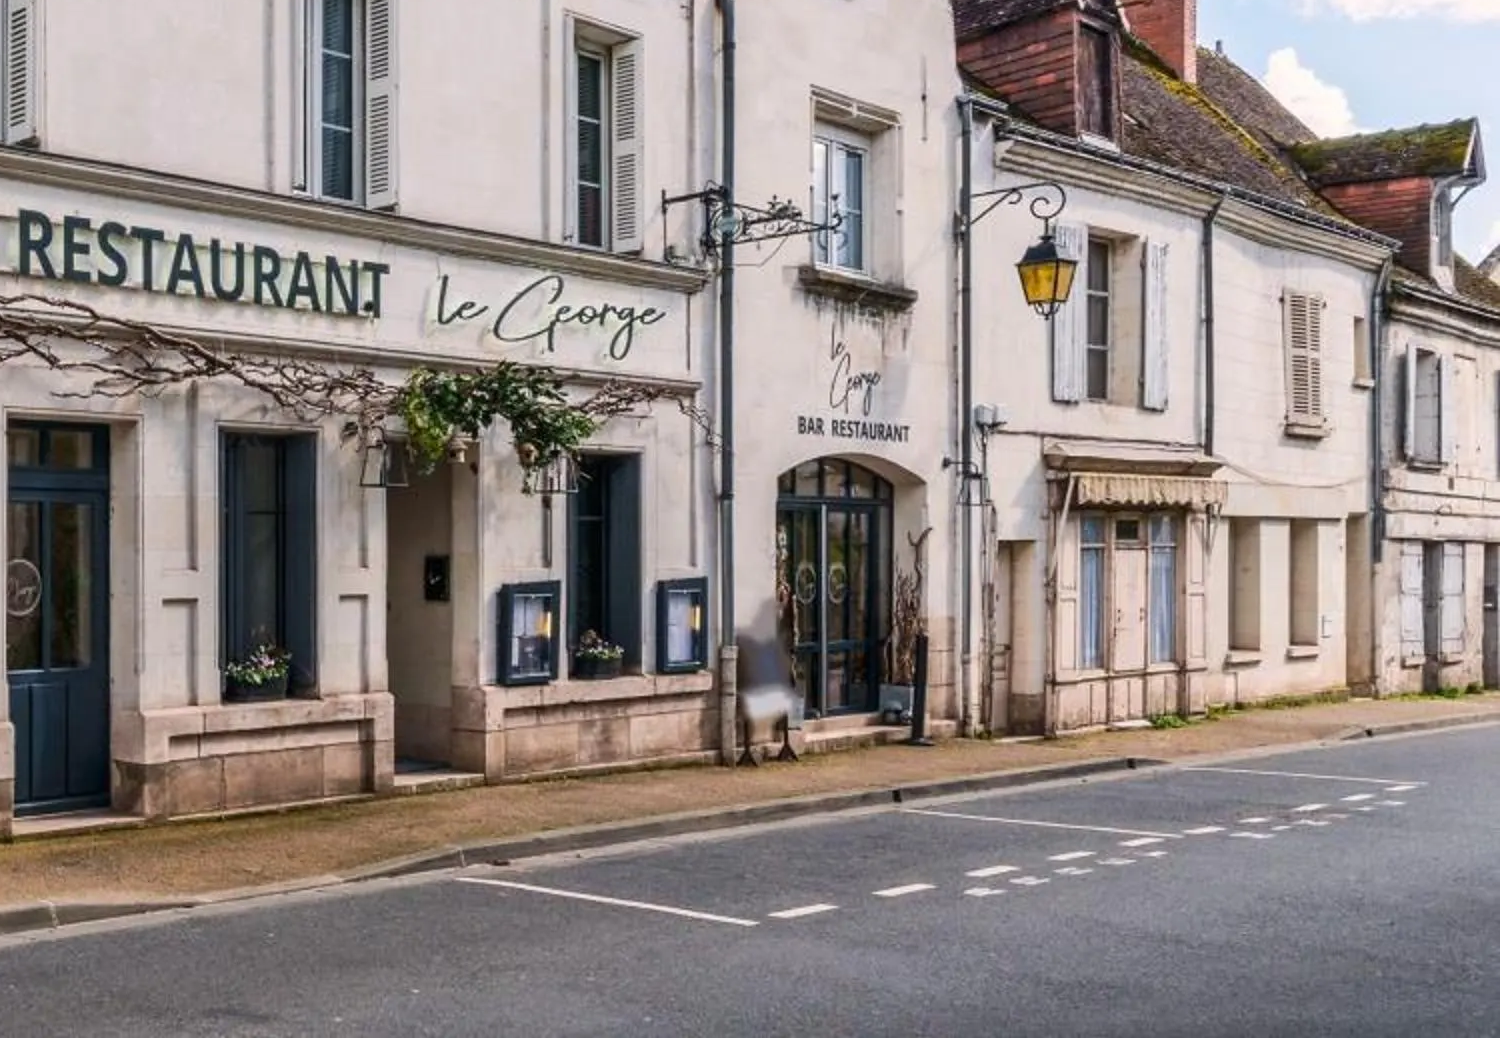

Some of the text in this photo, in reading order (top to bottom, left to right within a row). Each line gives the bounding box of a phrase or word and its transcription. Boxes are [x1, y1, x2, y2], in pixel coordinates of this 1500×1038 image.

[17, 208, 391, 319] RESTAURANT
[493, 275, 667, 361] George
[829, 351, 882, 418] George
[797, 415, 911, 443] BAR RESTAURANT
